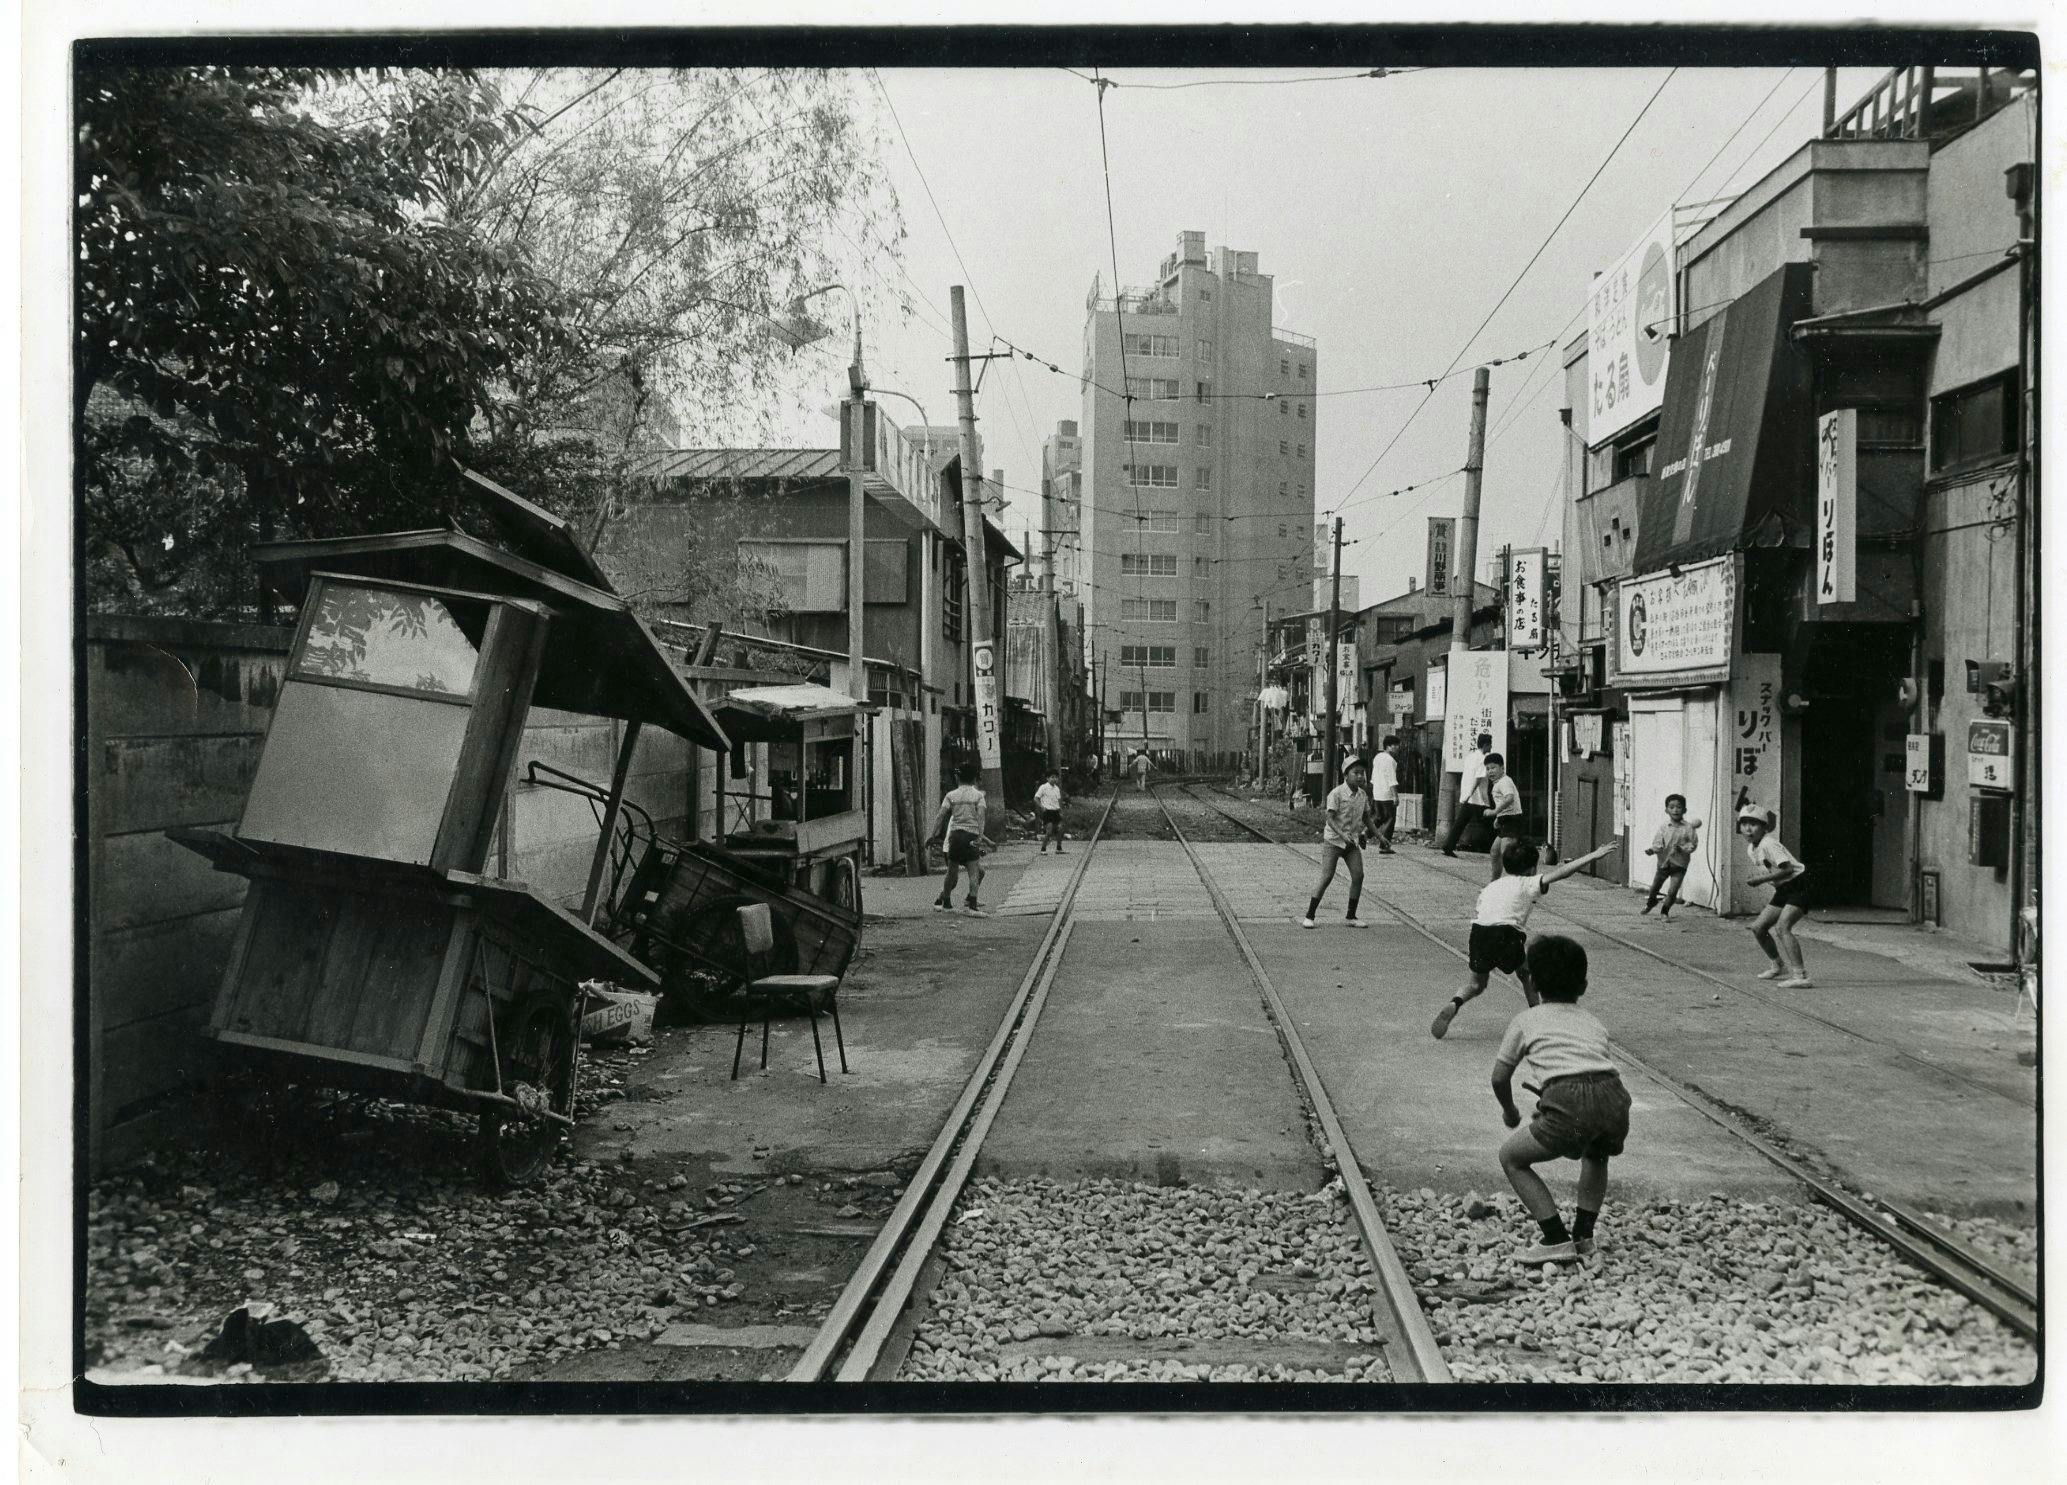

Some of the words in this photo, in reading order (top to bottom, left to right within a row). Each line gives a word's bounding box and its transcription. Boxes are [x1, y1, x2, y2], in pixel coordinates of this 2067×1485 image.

[1514, 560, 1526, 631] お食事の店
[1759, 683, 1772, 752] スナックバー
[607, 999, 640, 1026] EGGS
